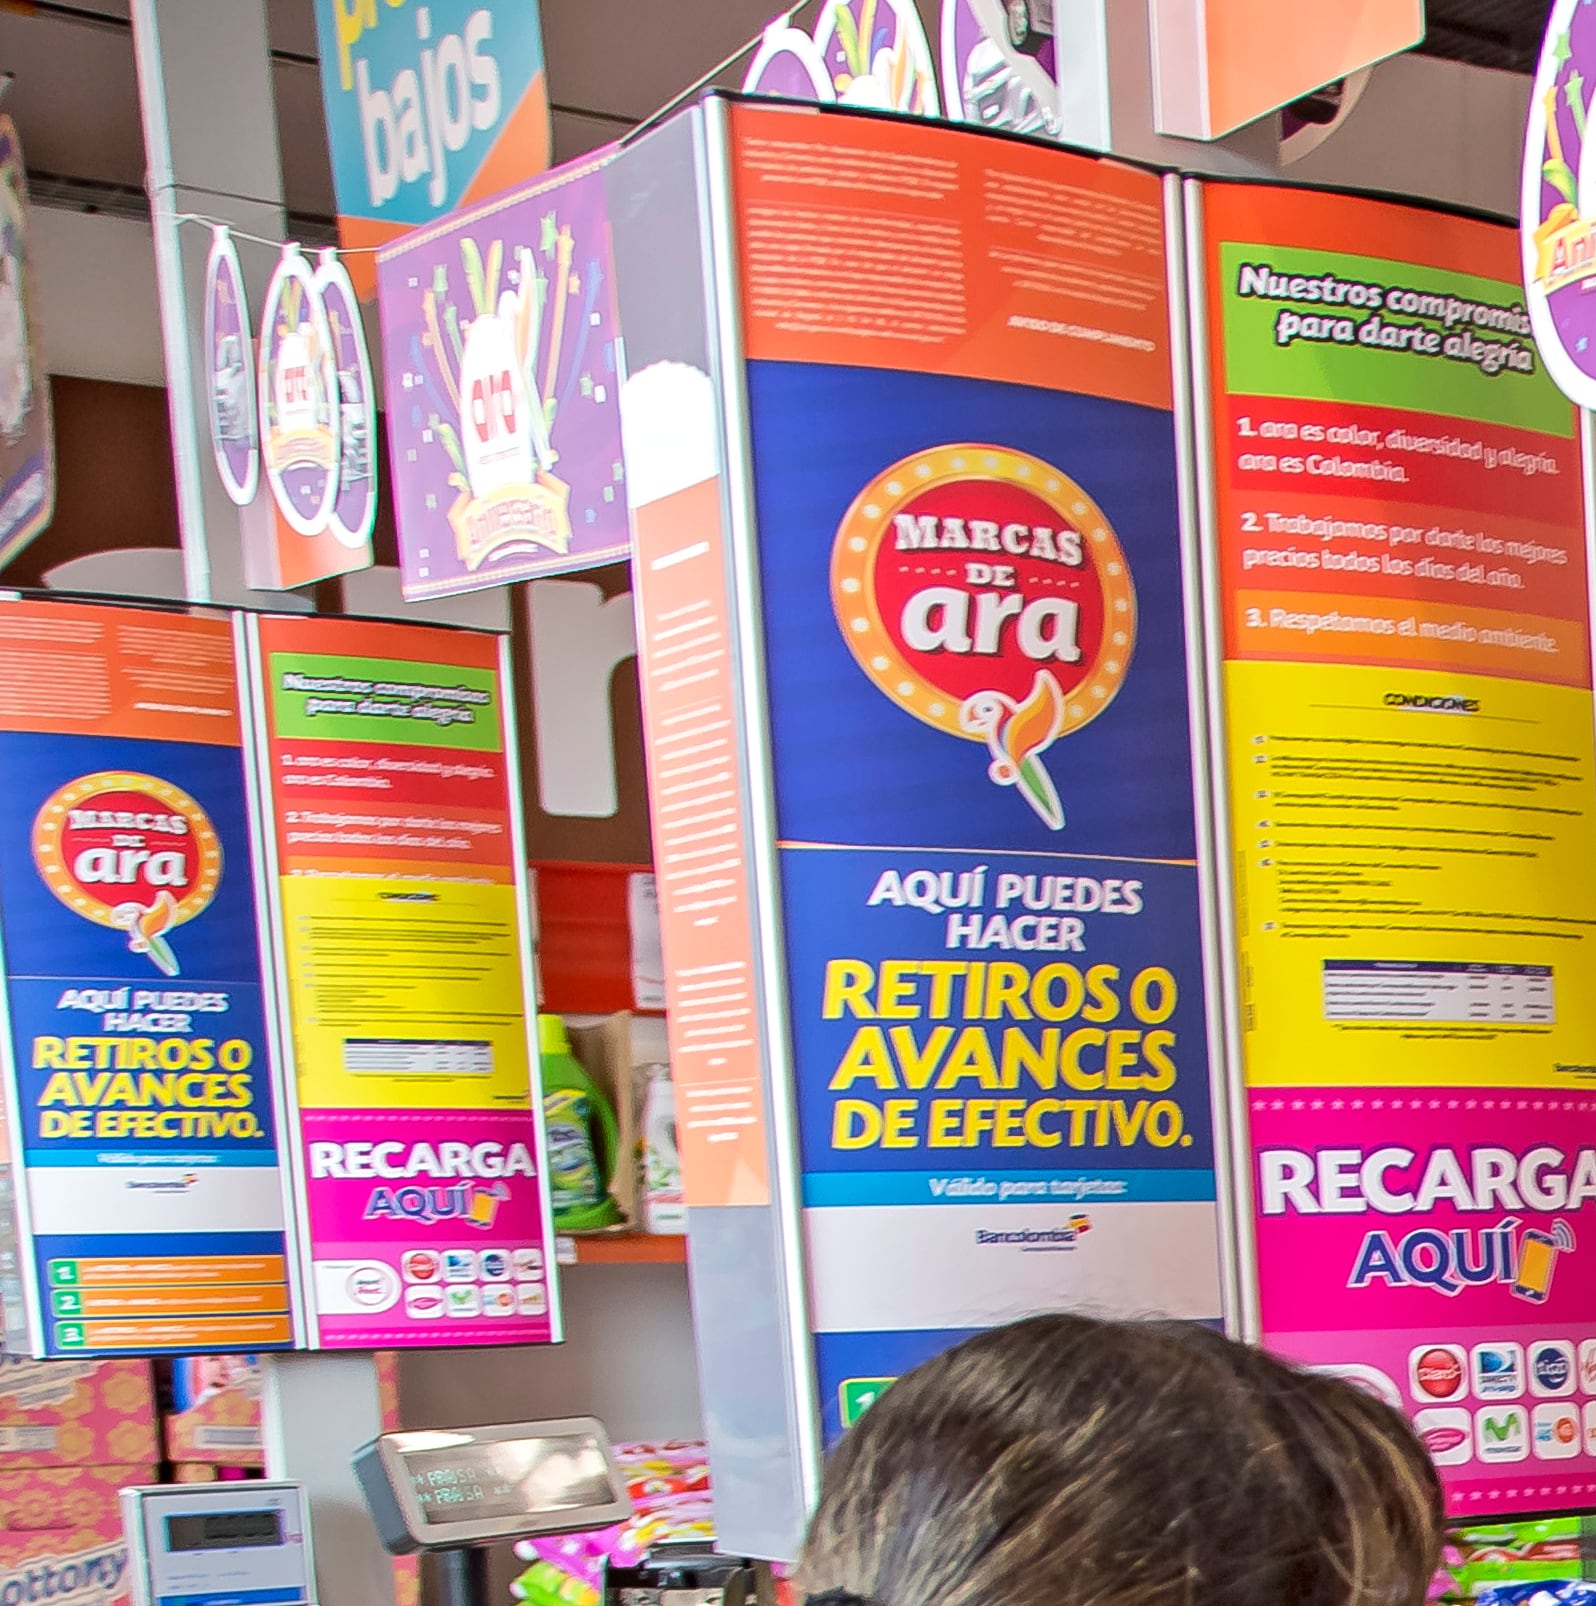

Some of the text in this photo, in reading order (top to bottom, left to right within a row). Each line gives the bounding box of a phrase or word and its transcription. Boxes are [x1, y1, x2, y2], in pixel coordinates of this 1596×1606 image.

[357, 6, 499, 208] bajos
[1239, 265, 1530, 336] Nuestros compromis
[1276, 309, 1534, 375] para darte alegría
[1299, 425, 1325, 441] es
[1385, 429, 1482, 463] diversidad
[1278, 456, 1303, 473] es
[1305, 453, 1411, 484] Colombia.
[894, 513, 1083, 567] MARCAS
[1264, 512, 1388, 542] Trabajamos
[1389, 525, 1425, 547] por
[1424, 527, 1475, 550] darte
[1475, 530, 1505, 556] los
[1504, 540, 1568, 567] mejores
[965, 562, 1016, 587] DE
[1242, 547, 1321, 570] precios
[1320, 550, 1381, 573] todos
[1381, 553, 1414, 576] los
[1413, 556, 1456, 581] días
[1455, 560, 1486, 585] del
[901, 586, 1082, 663] ara
[1268, 608, 1397, 637] Respetamos
[1397, 616, 1419, 638] el
[1419, 620, 1479, 642] medio
[68, 809, 189, 836] MARCAS
[73, 848, 189, 887] ara
[866, 864, 1144, 915] AQUÍ PUEDES
[944, 913, 1086, 952] HACER
[56, 986, 230, 1013] AQUÍ PUEDES
[821, 958, 1178, 1025] RETIROS O
[103, 1012, 193, 1033] HACER
[33, 1036, 253, 1072] RETIROS O
[827, 1025, 1178, 1092] AVANCES
[36, 1072, 254, 1108] AVANCES
[39, 1110, 265, 1139] DE EFECTIVO.
[831, 1098, 1194, 1150] DE EFECTIVO.
[308, 1141, 538, 1179] RECARGA
[363, 1179, 476, 1226] AQUÍ
[929, 1177, 997, 1198] Válido
[1346, 1215, 1523, 1299] AQUÍ
